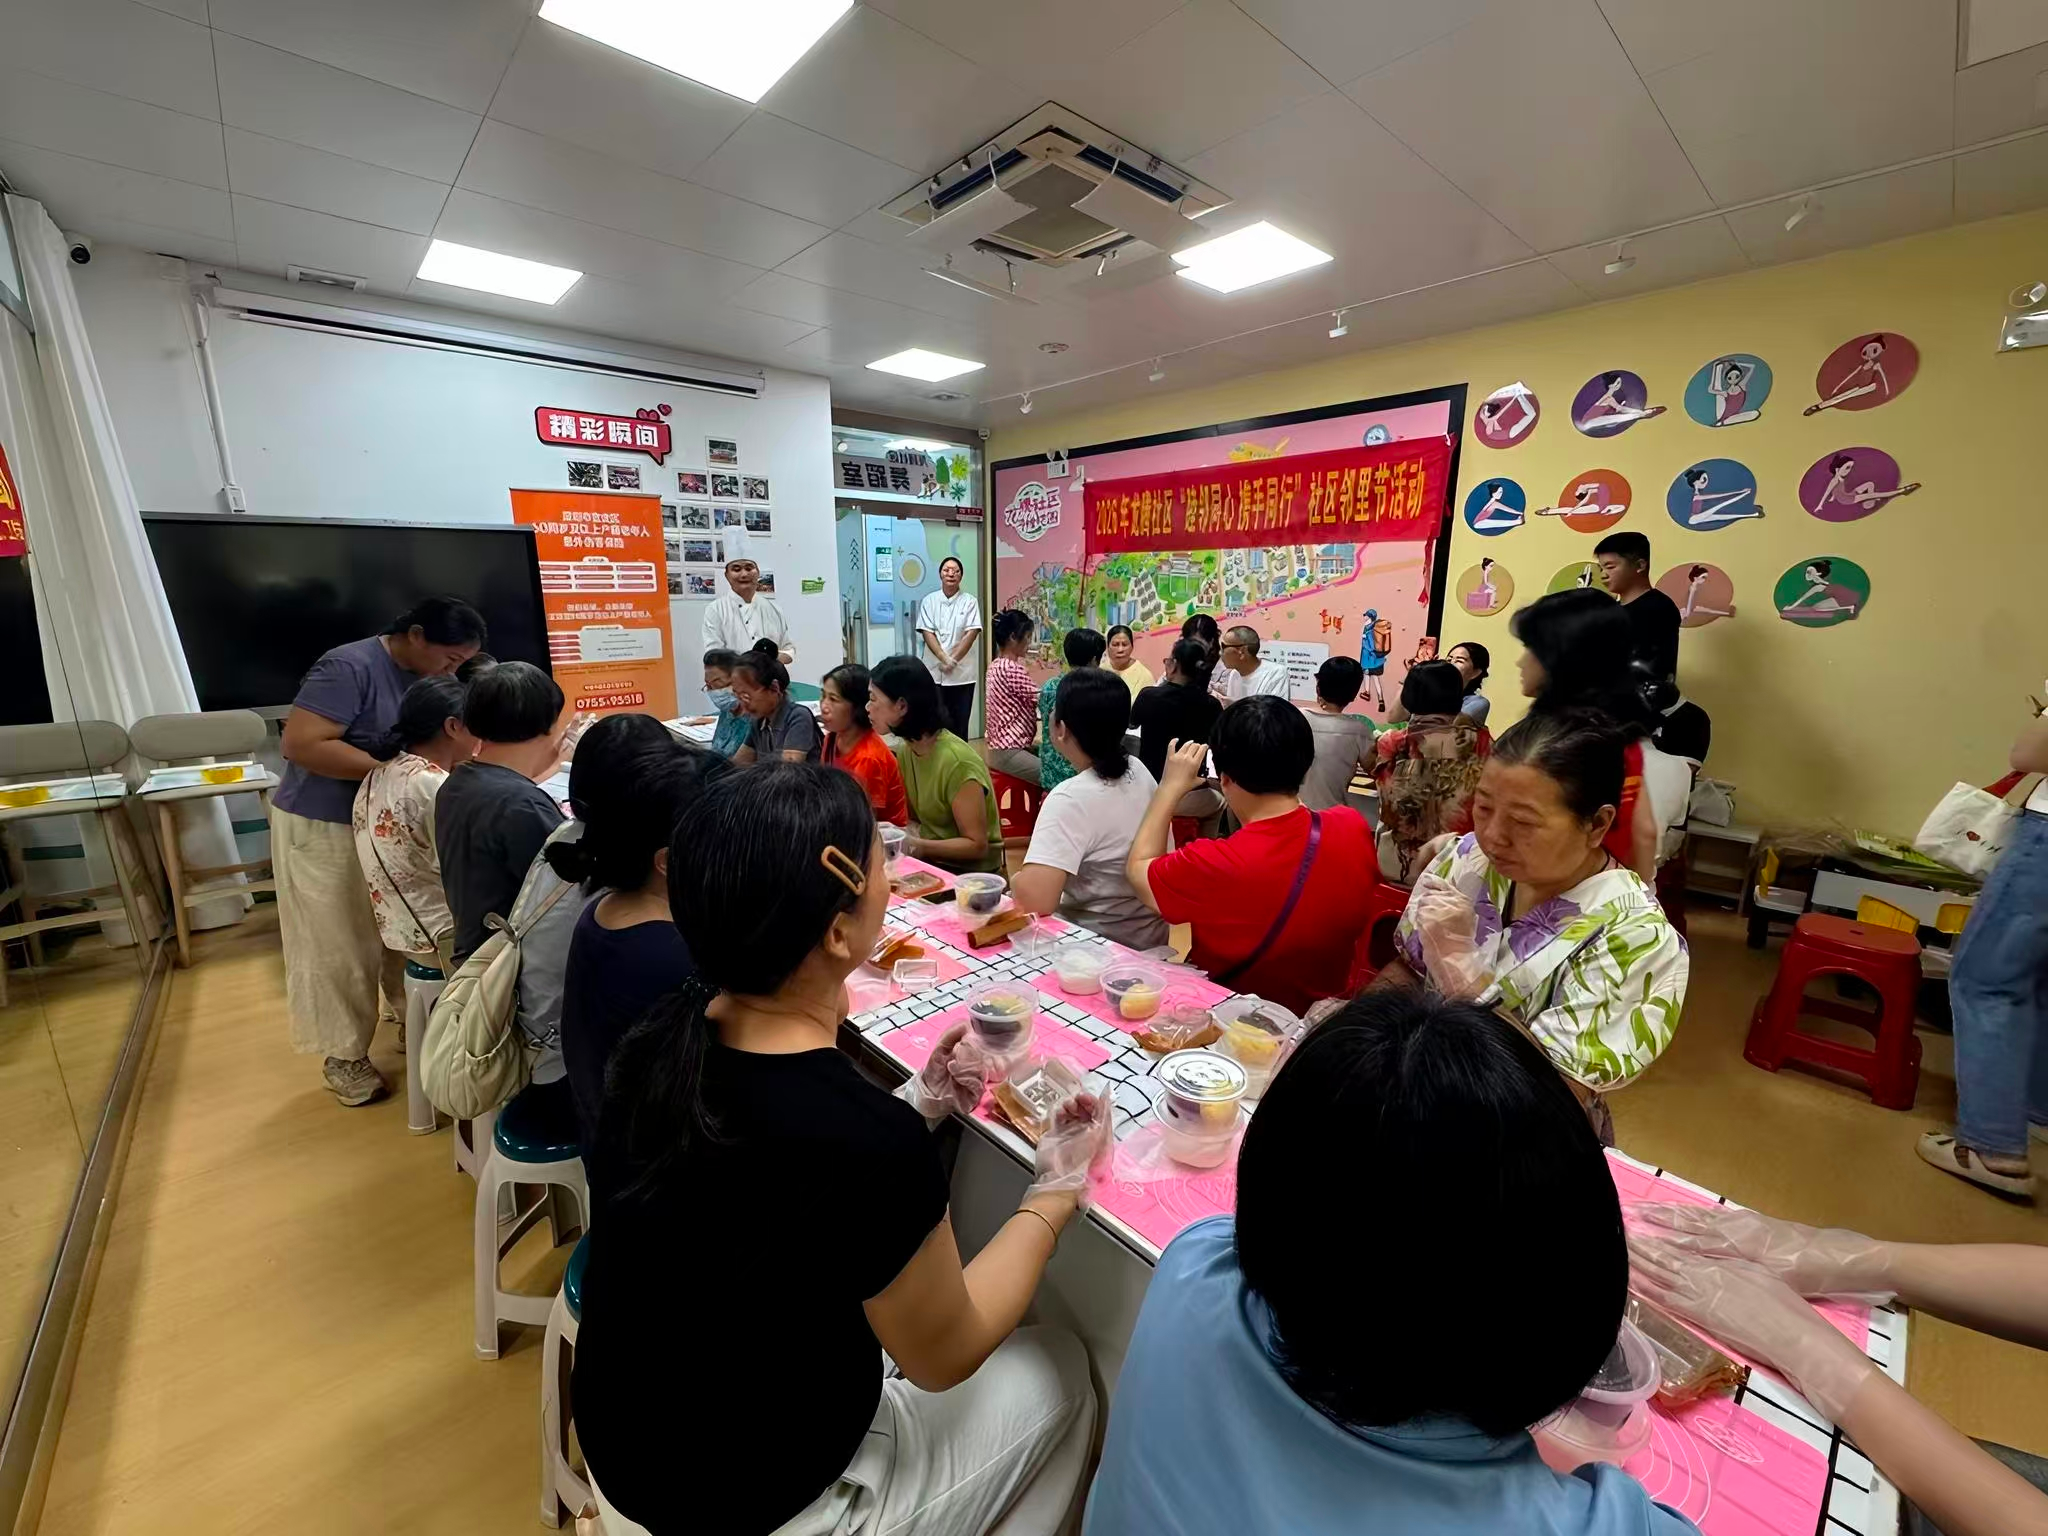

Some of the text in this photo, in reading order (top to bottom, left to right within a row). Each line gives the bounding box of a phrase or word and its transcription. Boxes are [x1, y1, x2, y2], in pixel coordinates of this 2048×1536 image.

[548, 414, 659, 448] 精彩瞬间
[1308, 457, 1427, 528] 社区邻里节活动
